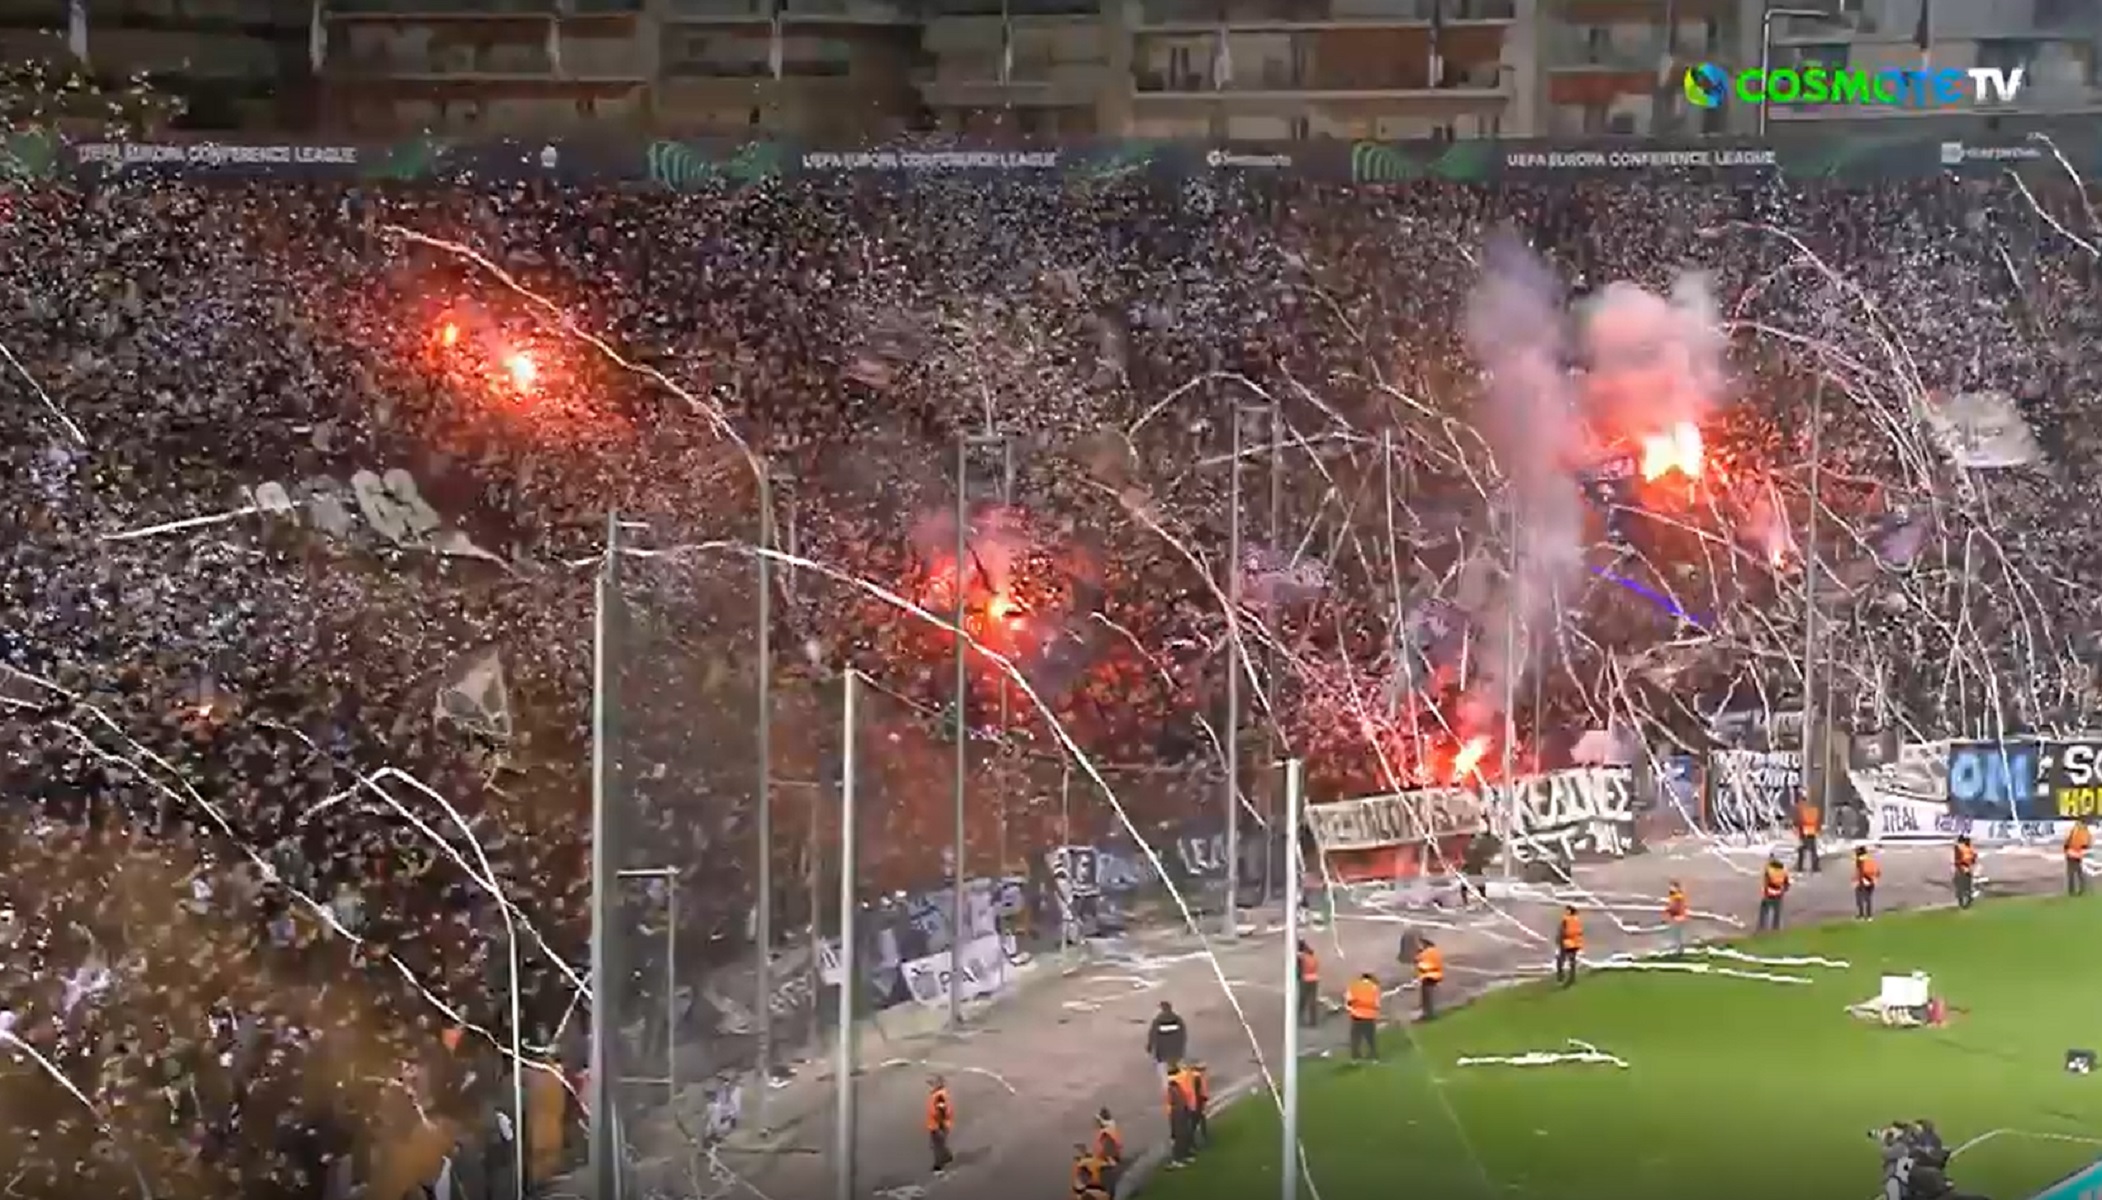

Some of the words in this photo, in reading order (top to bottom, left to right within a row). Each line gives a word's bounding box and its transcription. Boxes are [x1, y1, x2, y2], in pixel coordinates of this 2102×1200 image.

[294, 147, 358, 163] LEAGUE
[1000, 151, 1056, 167] LEAGUE
[1507, 153, 1547, 167] UEFA
[1548, 152, 1606, 167] EUROPA
[1608, 151, 1711, 166] CONFERENCE
[1714, 150, 1777, 165] LEAGUE
